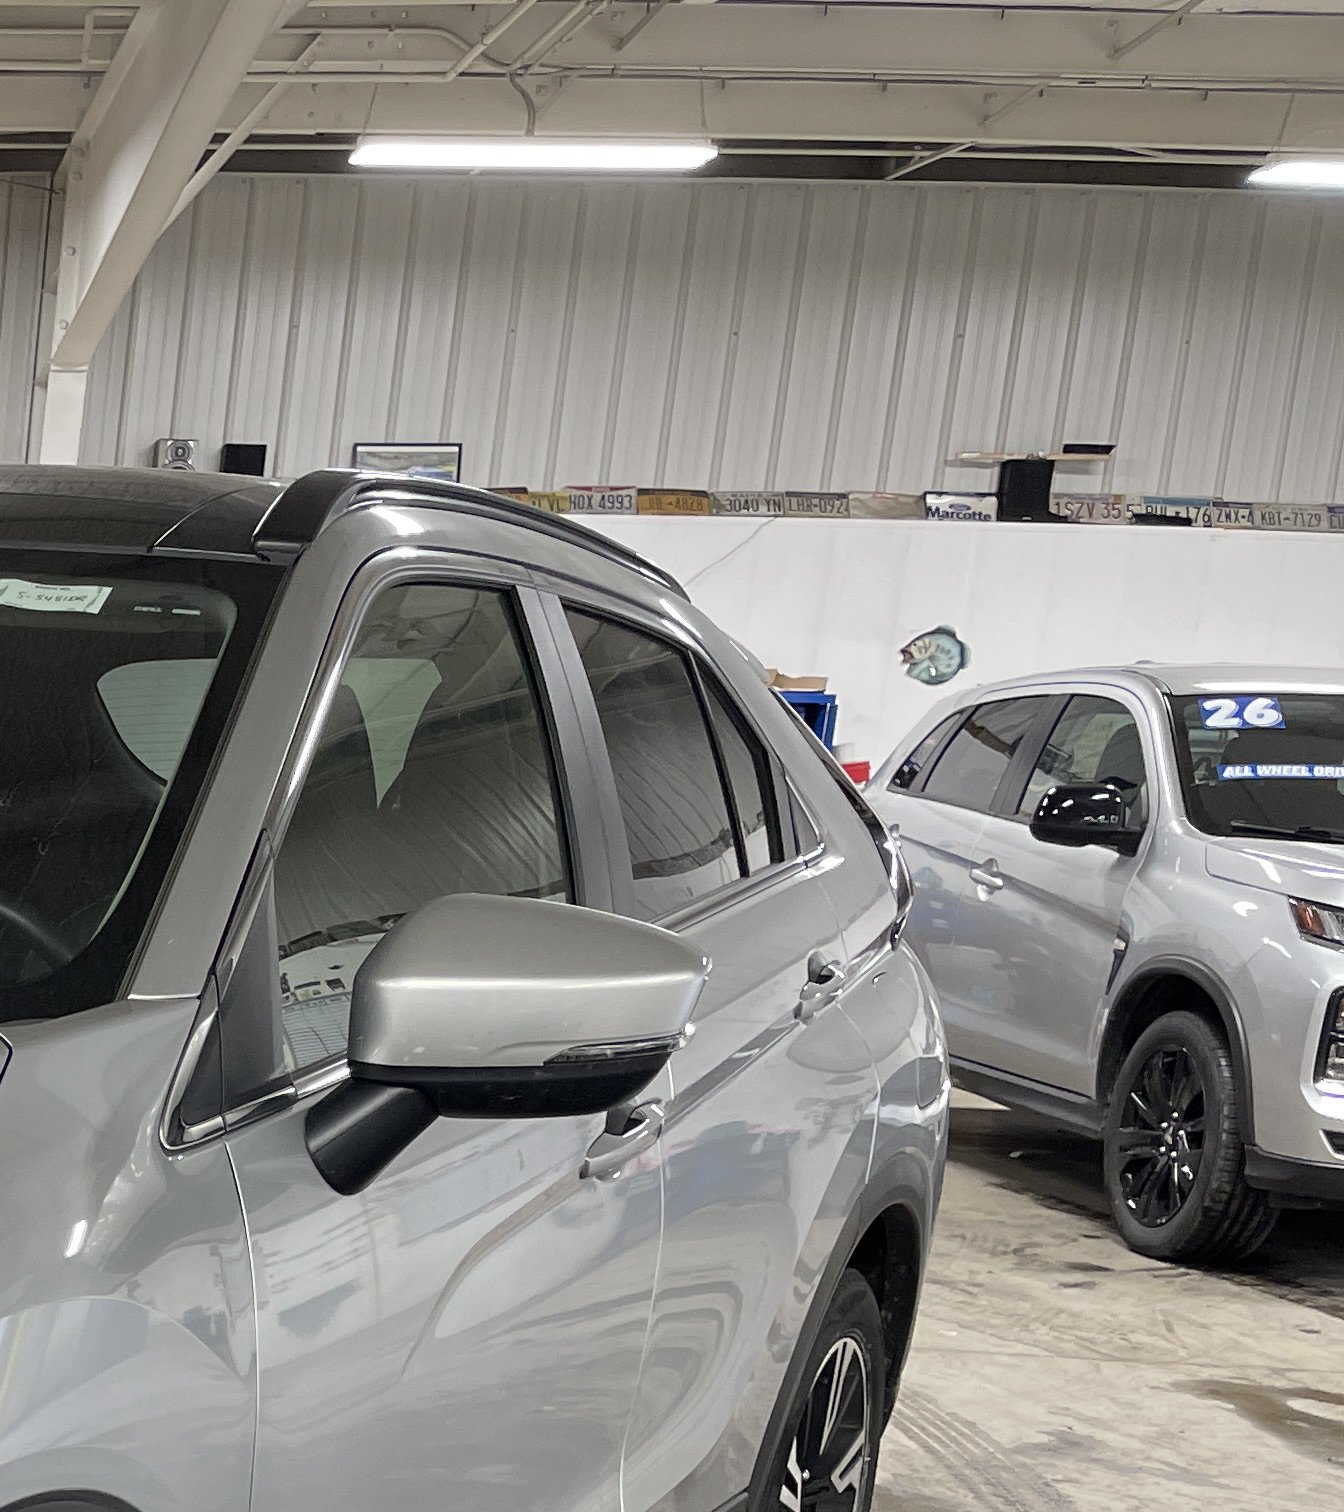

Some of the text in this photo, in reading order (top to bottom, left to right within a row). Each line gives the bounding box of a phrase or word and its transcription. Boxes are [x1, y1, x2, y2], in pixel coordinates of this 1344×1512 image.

[569, 495, 633, 510] HOX 4993
[725, 498, 759, 513] 3040
[927, 506, 992, 521] Marcotte
[1101, 502, 1121, 520] 35
[1202, 697, 1283, 728] 26
[1223, 764, 1344, 779] ALL WHEEL DRI
